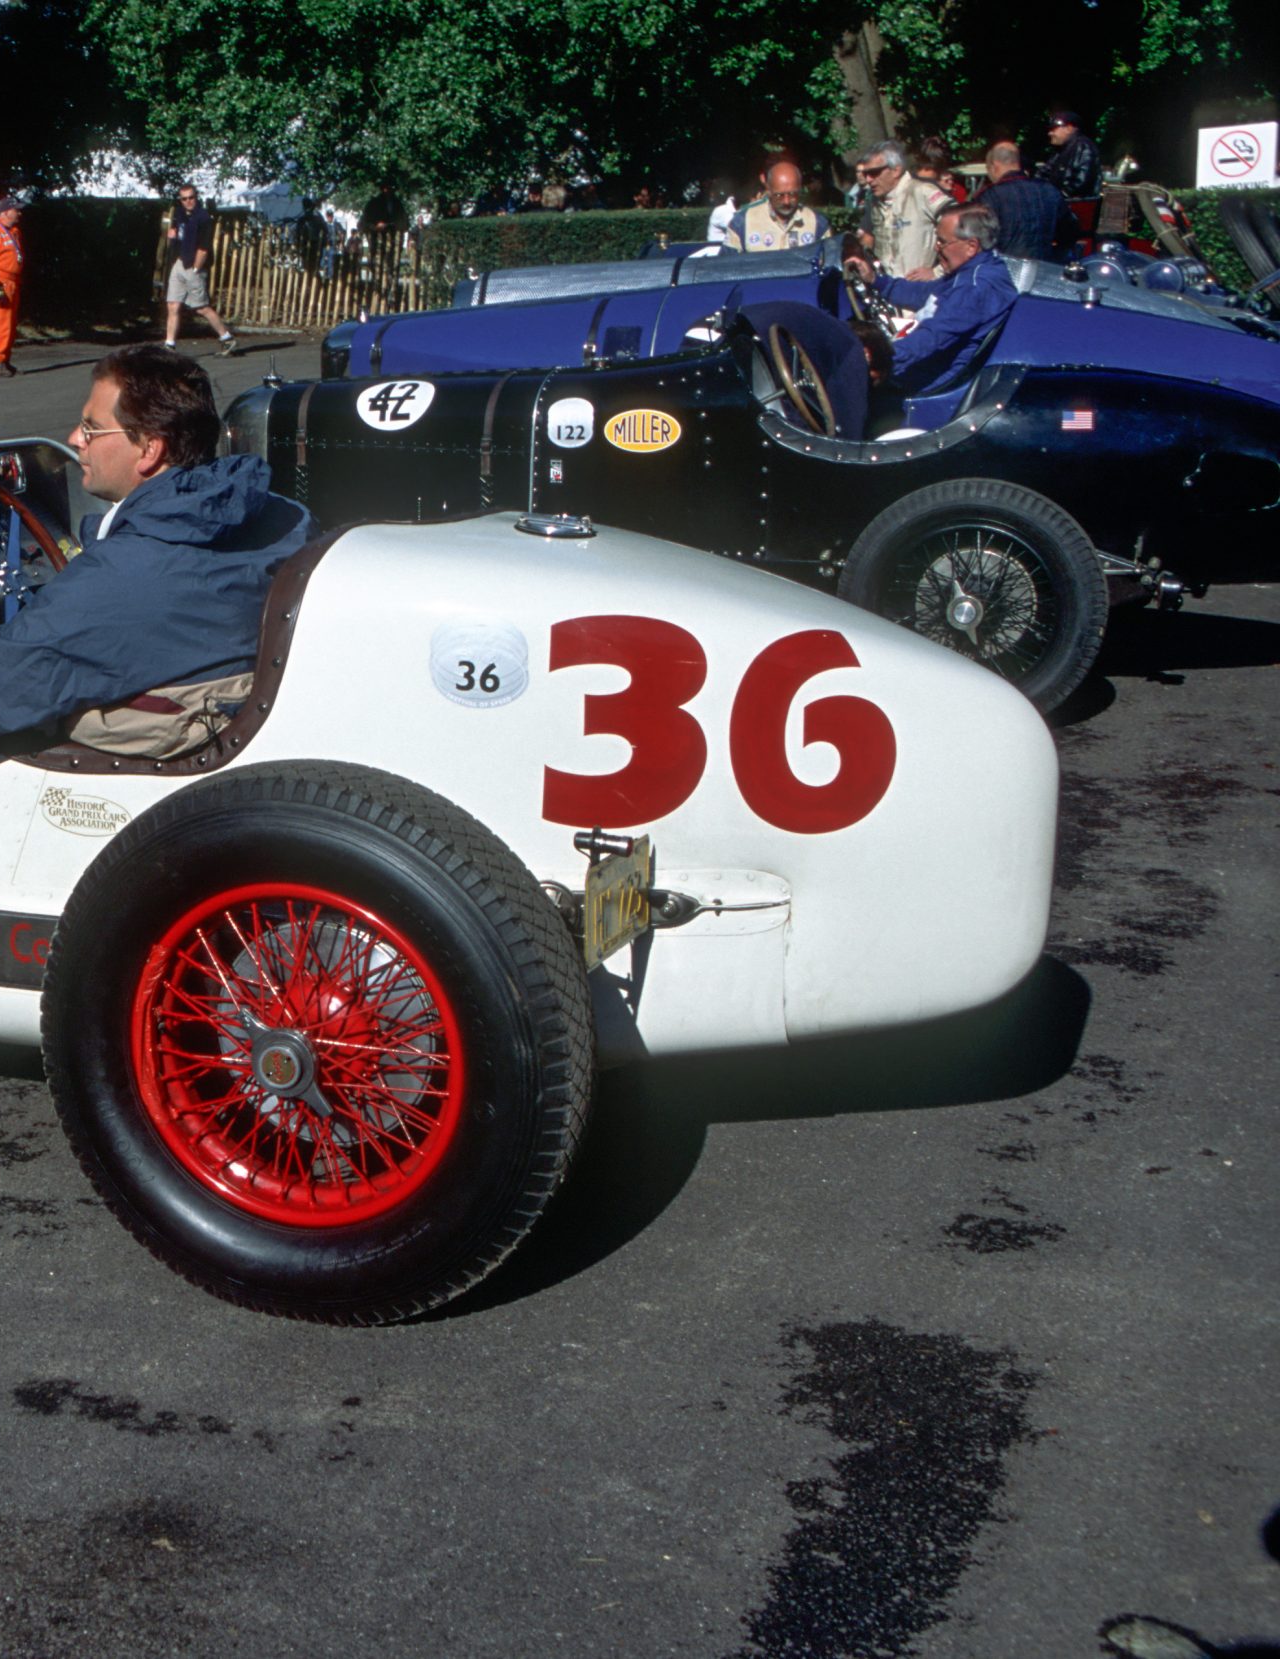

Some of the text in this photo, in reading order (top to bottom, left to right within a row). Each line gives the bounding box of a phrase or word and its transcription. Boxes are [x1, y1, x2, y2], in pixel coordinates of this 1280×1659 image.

[368, 383, 420, 422] 42
[557, 425, 586, 440] 122
[614, 413, 671, 443] MILLER
[456, 660, 500, 693] 36
[542, 615, 897, 835] 36
